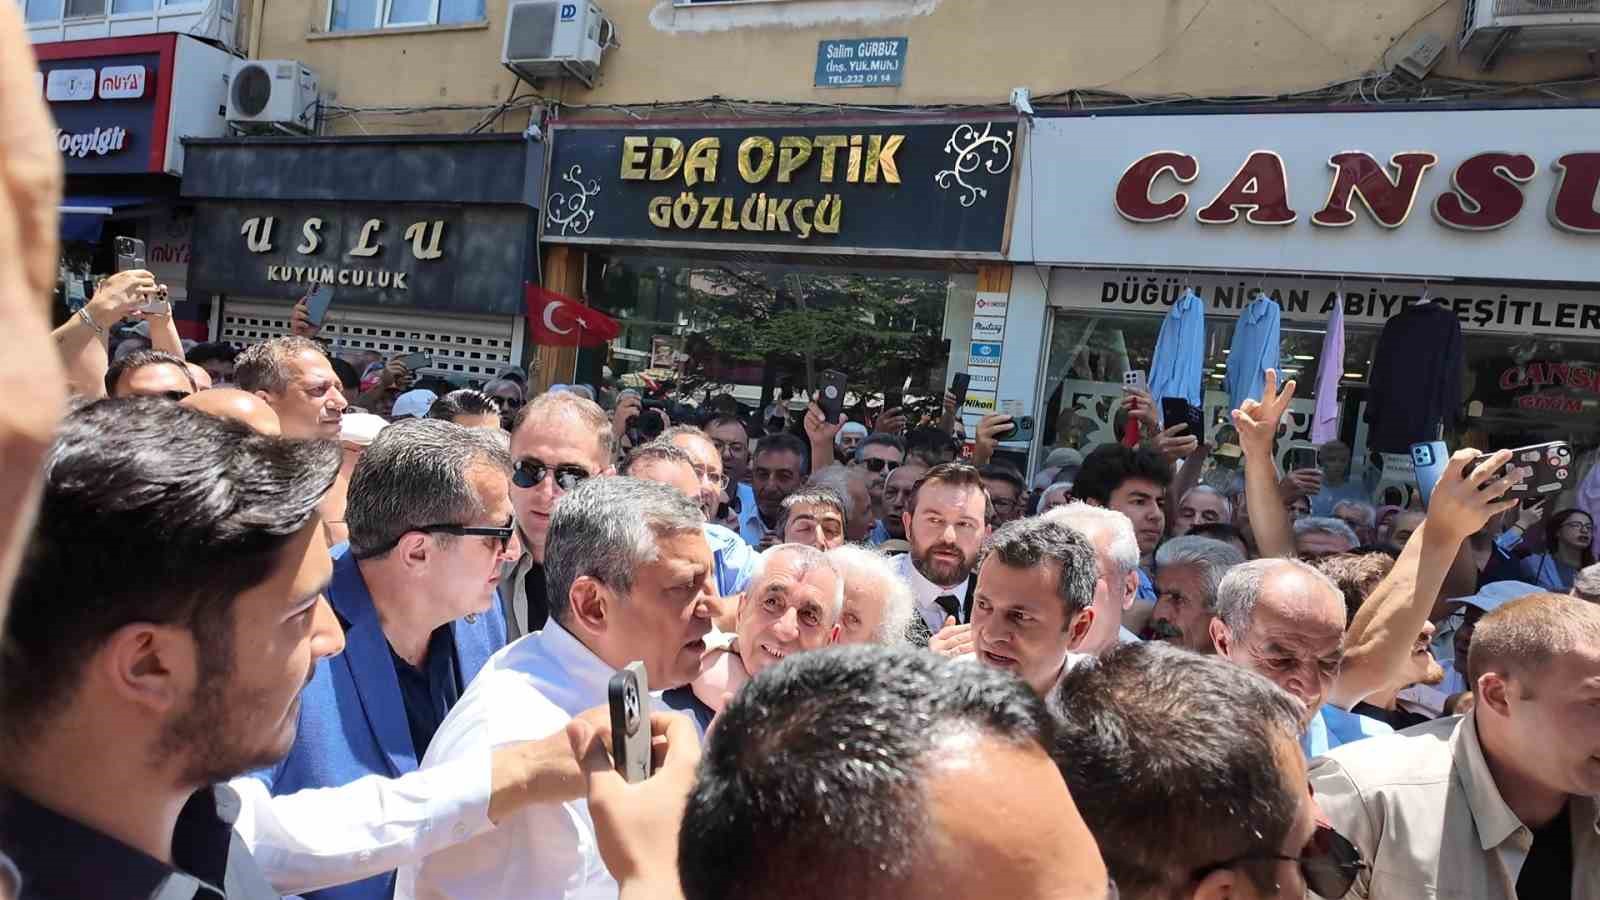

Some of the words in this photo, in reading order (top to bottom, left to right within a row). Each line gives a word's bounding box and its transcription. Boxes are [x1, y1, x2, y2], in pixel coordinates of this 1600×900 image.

[827, 44, 853, 58] Salim
[858, 41, 898, 57] GÜRBÜZ
[620, 136, 721, 187] EDA
[737, 134, 905, 184] OPTİK
[241, 216, 444, 259] USLU
[648, 191, 841, 239] GÖZLÜKÇÜ
[267, 264, 408, 289] KUYUMCULUK
[1101, 276, 1202, 304] DÜĞÜ
[1431, 294, 1600, 330] EŞİTLER
